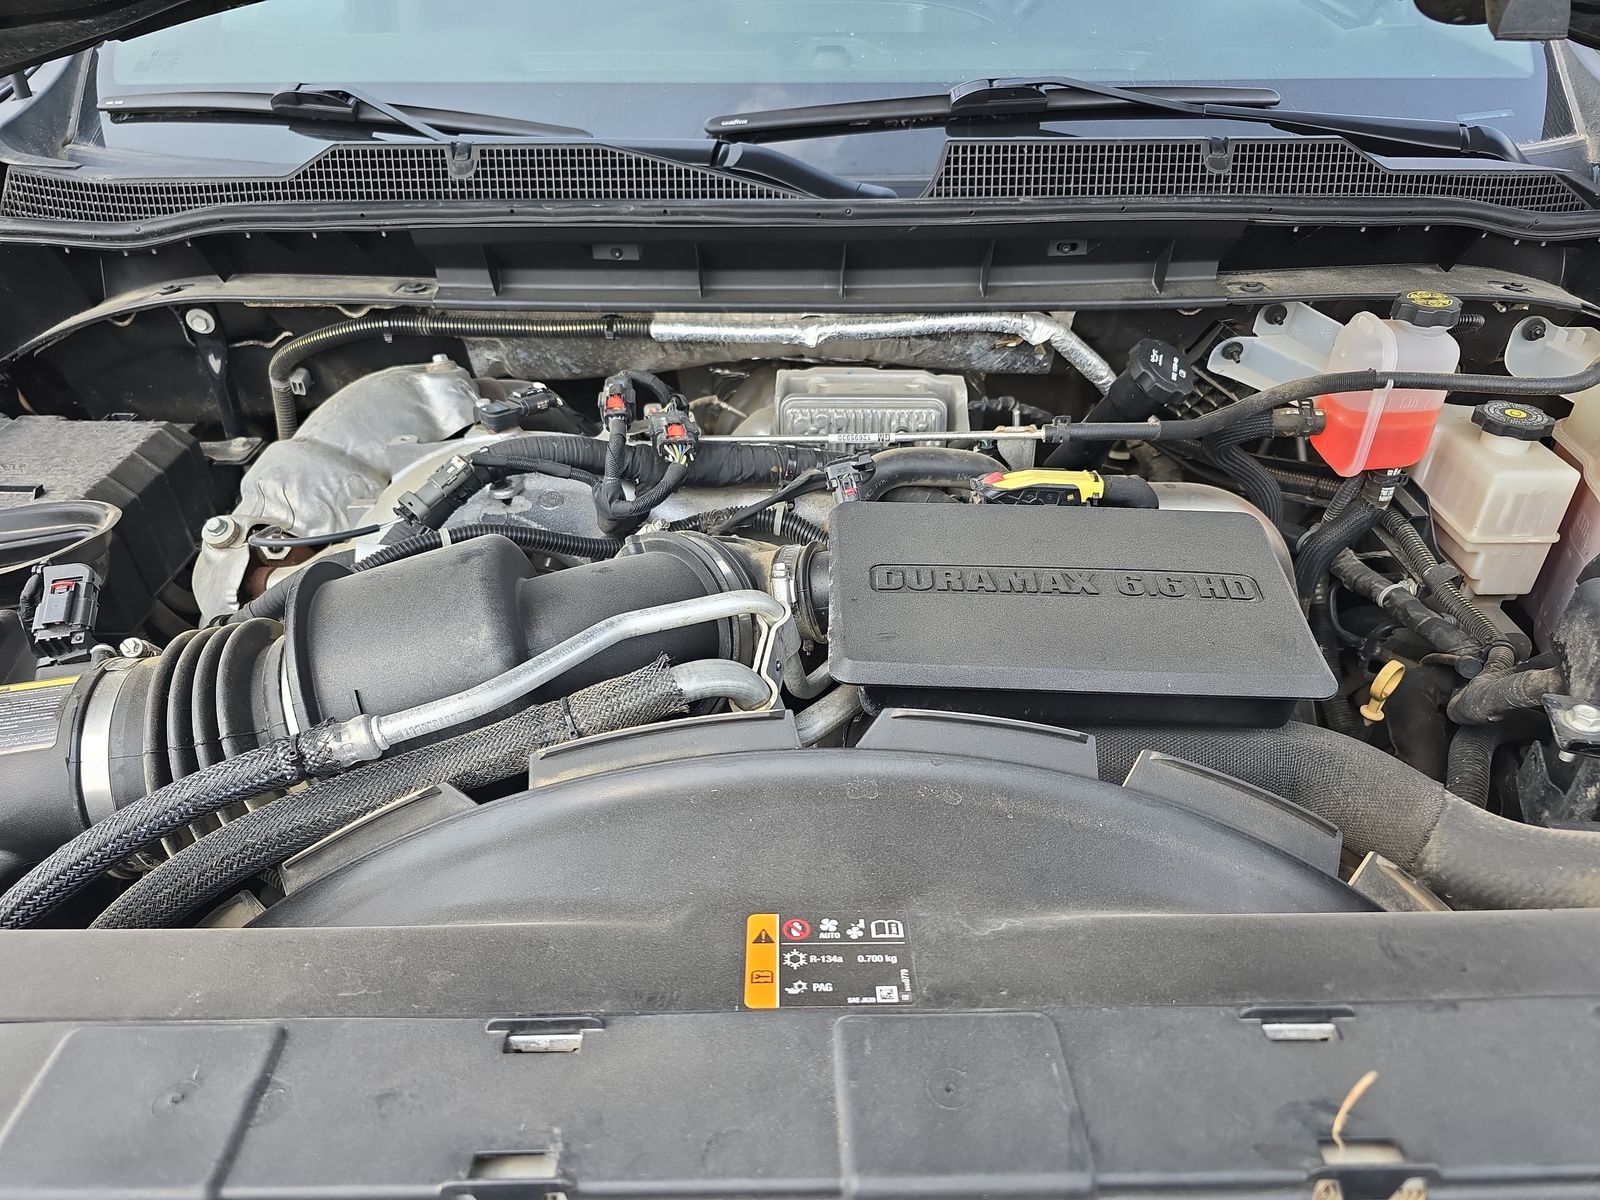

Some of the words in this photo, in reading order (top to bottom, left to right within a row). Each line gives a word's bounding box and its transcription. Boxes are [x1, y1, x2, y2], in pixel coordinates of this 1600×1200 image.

[877, 433, 891, 442] GM
[875, 568, 1100, 595] DURAMAX
[1115, 573, 1187, 598] 6.6
[1193, 575, 1256, 601] HD
[818, 931, 841, 939] AUTO
[809, 954, 844, 963] R-134a
[857, 954, 883, 963] 0.700
[884, 954, 898, 964] kg
[812, 983, 833, 992] PAG
